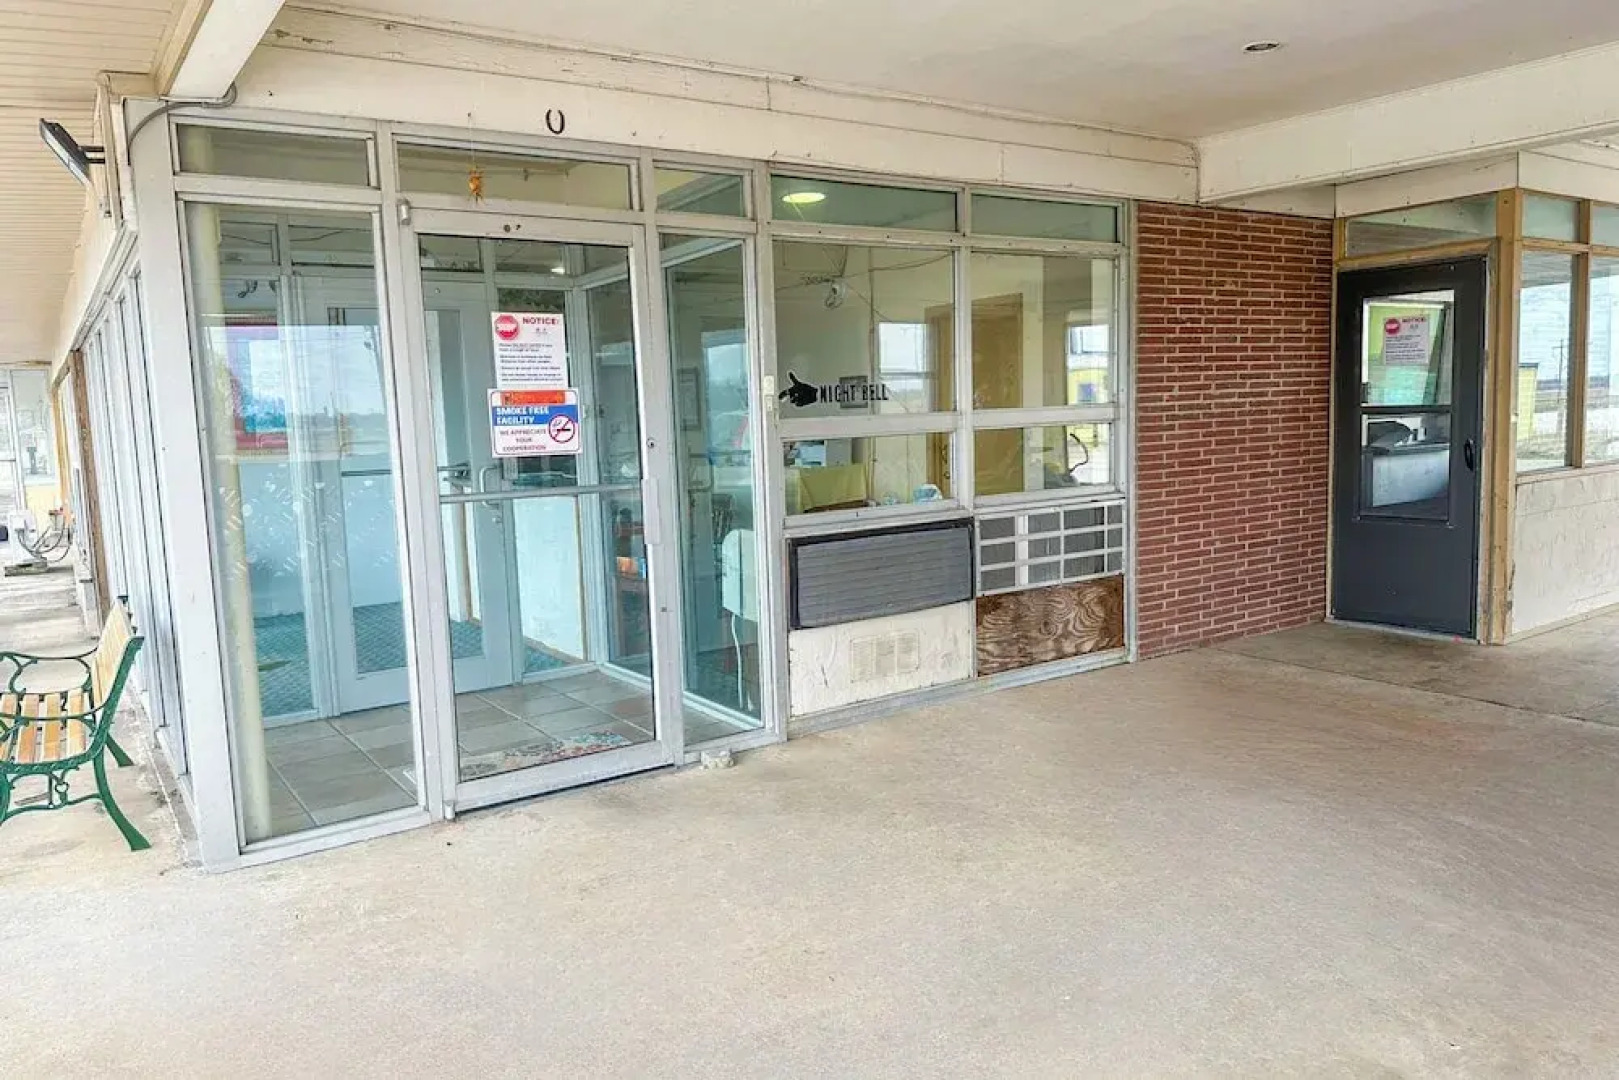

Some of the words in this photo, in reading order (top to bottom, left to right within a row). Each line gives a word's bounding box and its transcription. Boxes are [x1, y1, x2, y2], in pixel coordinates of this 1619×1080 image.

[820, 384, 856, 403] NIGHT
[862, 383, 889, 401] BELL
[496, 406, 527, 415] SMOKE
[528, 406, 550, 415] FREE
[496, 416, 535, 425] FACILITY
